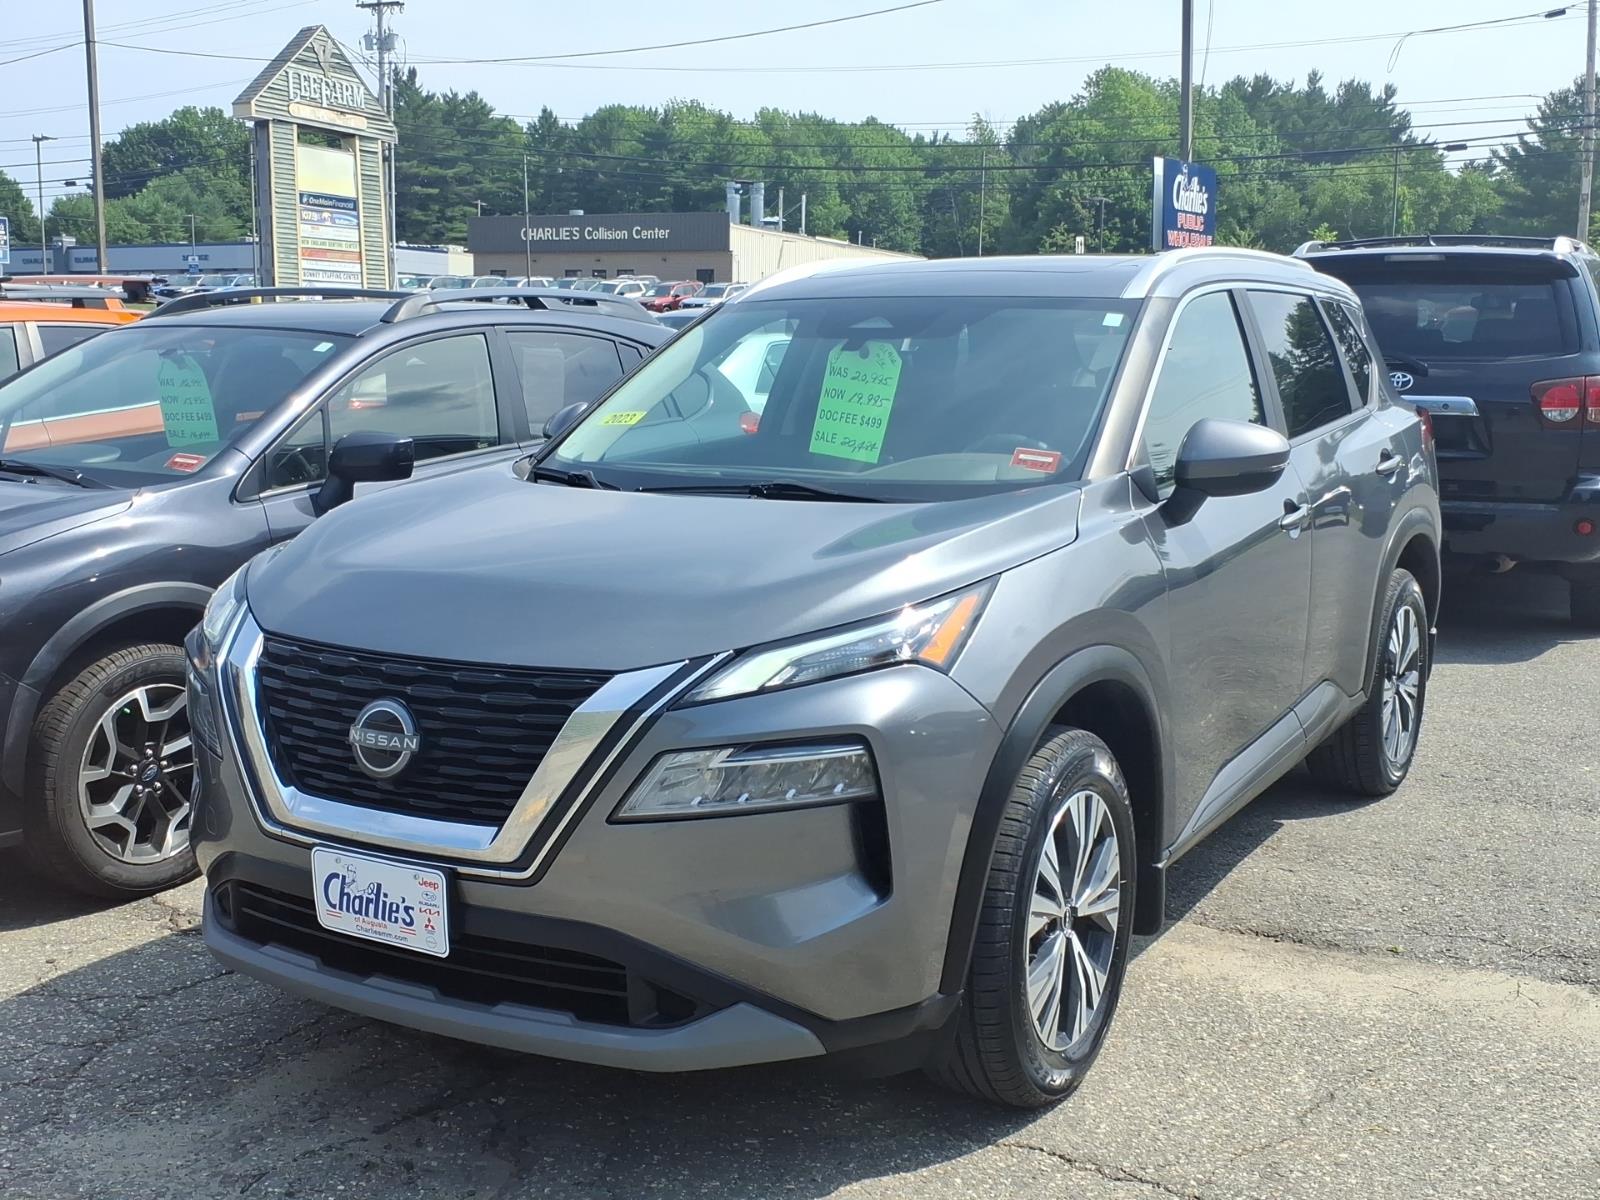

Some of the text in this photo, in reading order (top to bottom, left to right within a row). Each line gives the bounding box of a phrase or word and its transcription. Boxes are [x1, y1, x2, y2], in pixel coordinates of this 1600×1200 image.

[285, 69, 365, 110] LEE FARM
[1173, 174, 1208, 214] Charlie's
[1177, 212, 1205, 232] PUBLIC
[521, 226, 670, 241] CHARLIE'S Collision Center
[828, 365, 849, 378] WAS
[823, 386, 846, 401] NOW
[819, 408, 882, 429] DOC FEE $499
[814, 430, 837, 444] SALE
[351, 729, 417, 749] NISSAN
[418, 877, 439, 891] Jeep
[323, 872, 415, 928] Charlie's
